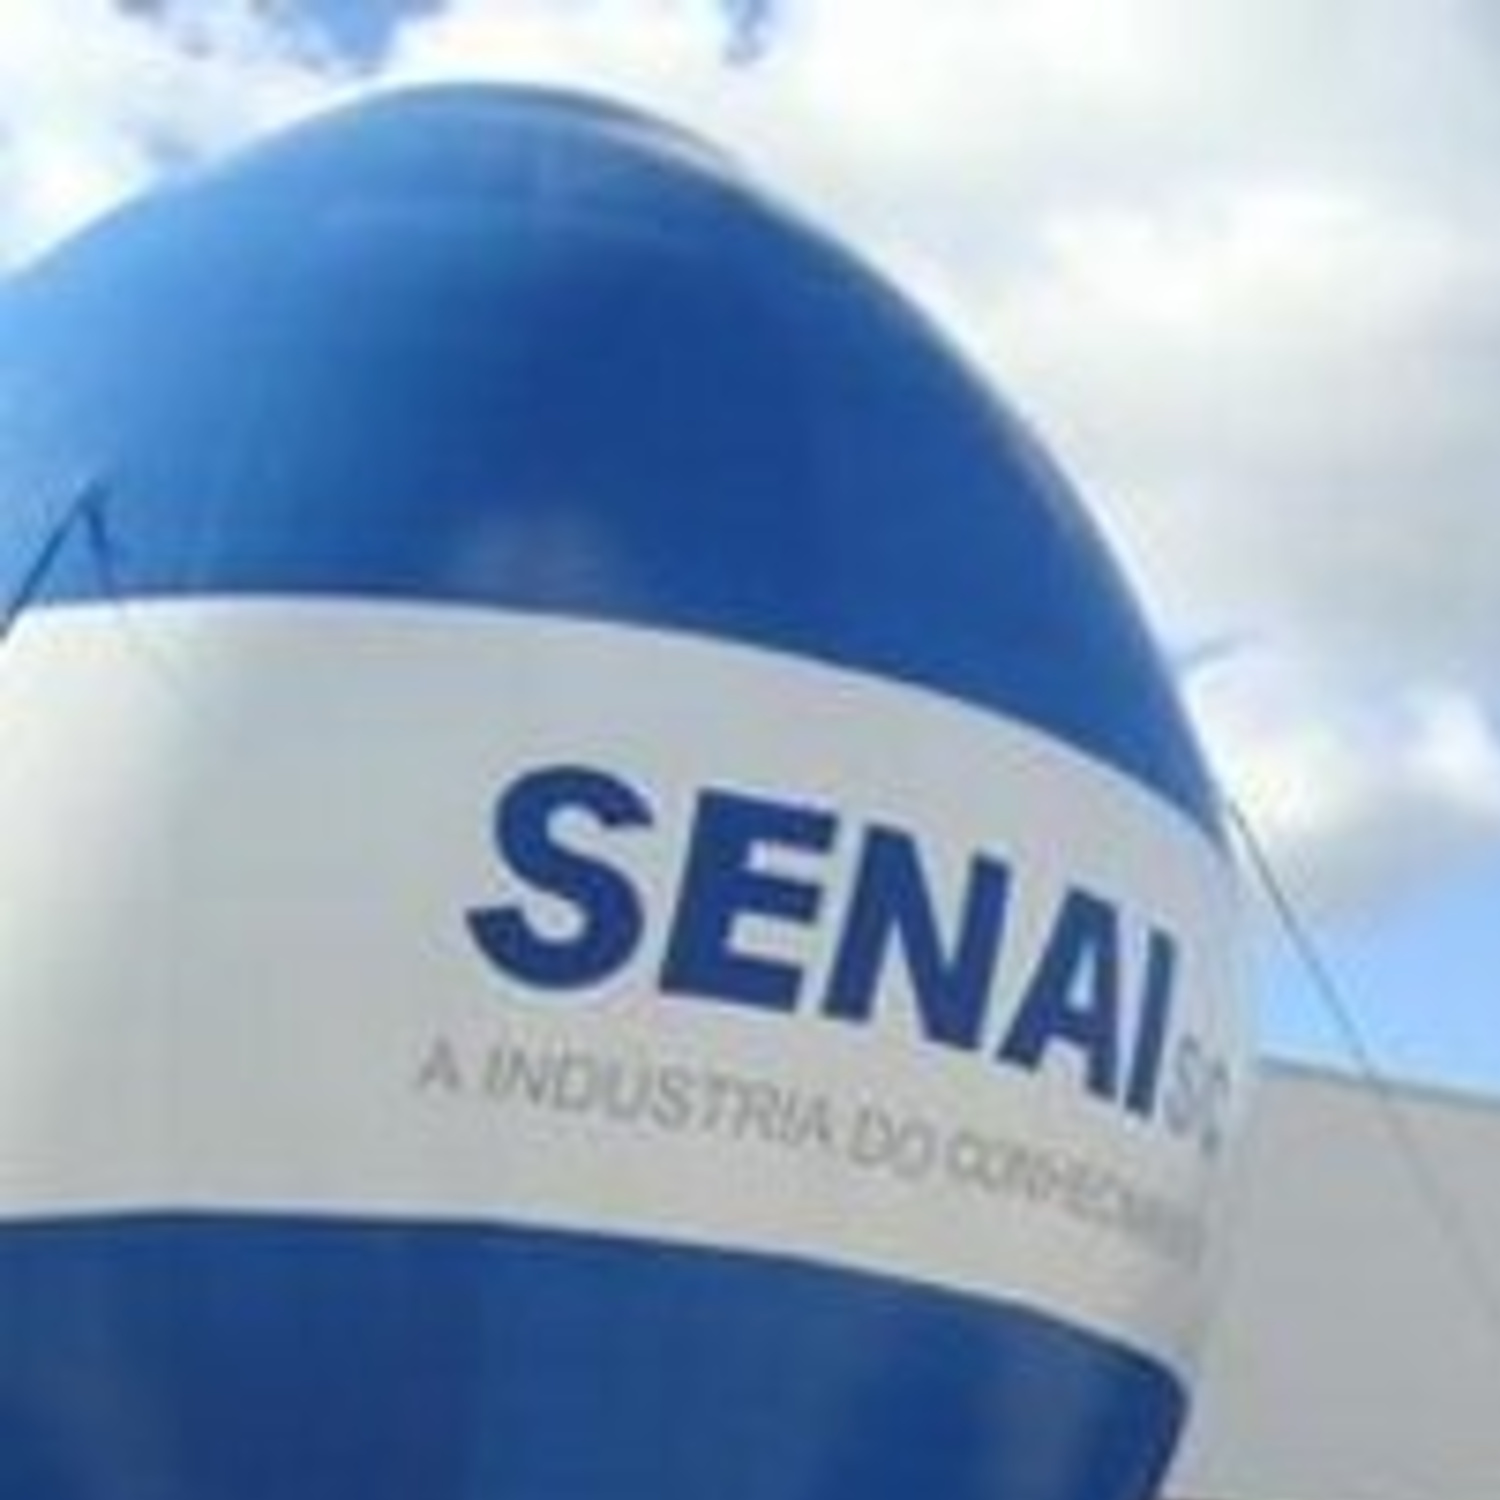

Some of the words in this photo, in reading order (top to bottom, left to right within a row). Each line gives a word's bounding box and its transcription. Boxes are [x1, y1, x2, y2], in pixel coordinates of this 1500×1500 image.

[465, 765, 1178, 1121] SENAI
[418, 1038, 460, 1091] A
[849, 1098, 936, 1179] DO
